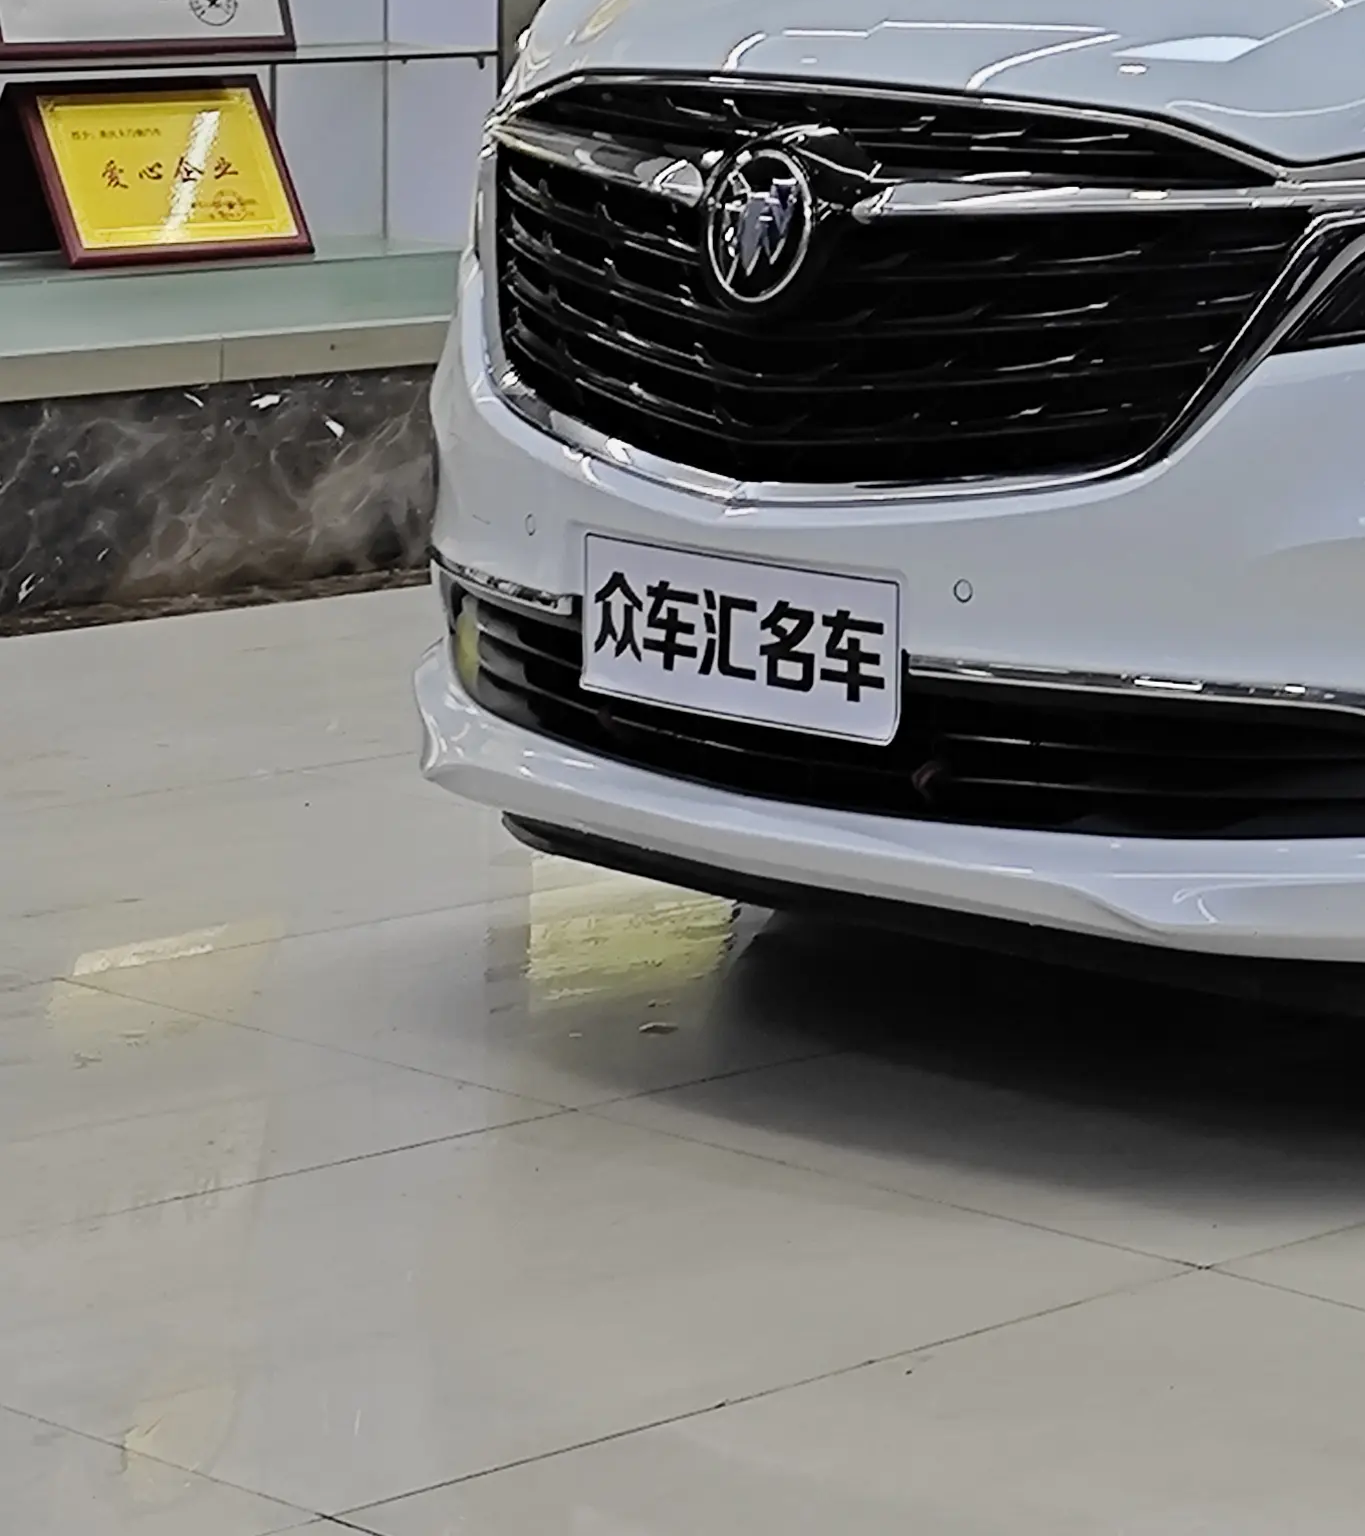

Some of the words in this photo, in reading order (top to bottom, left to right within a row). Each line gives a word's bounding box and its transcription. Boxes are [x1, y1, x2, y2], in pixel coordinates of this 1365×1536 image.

[594, 571, 886, 703] 众车汇名车
